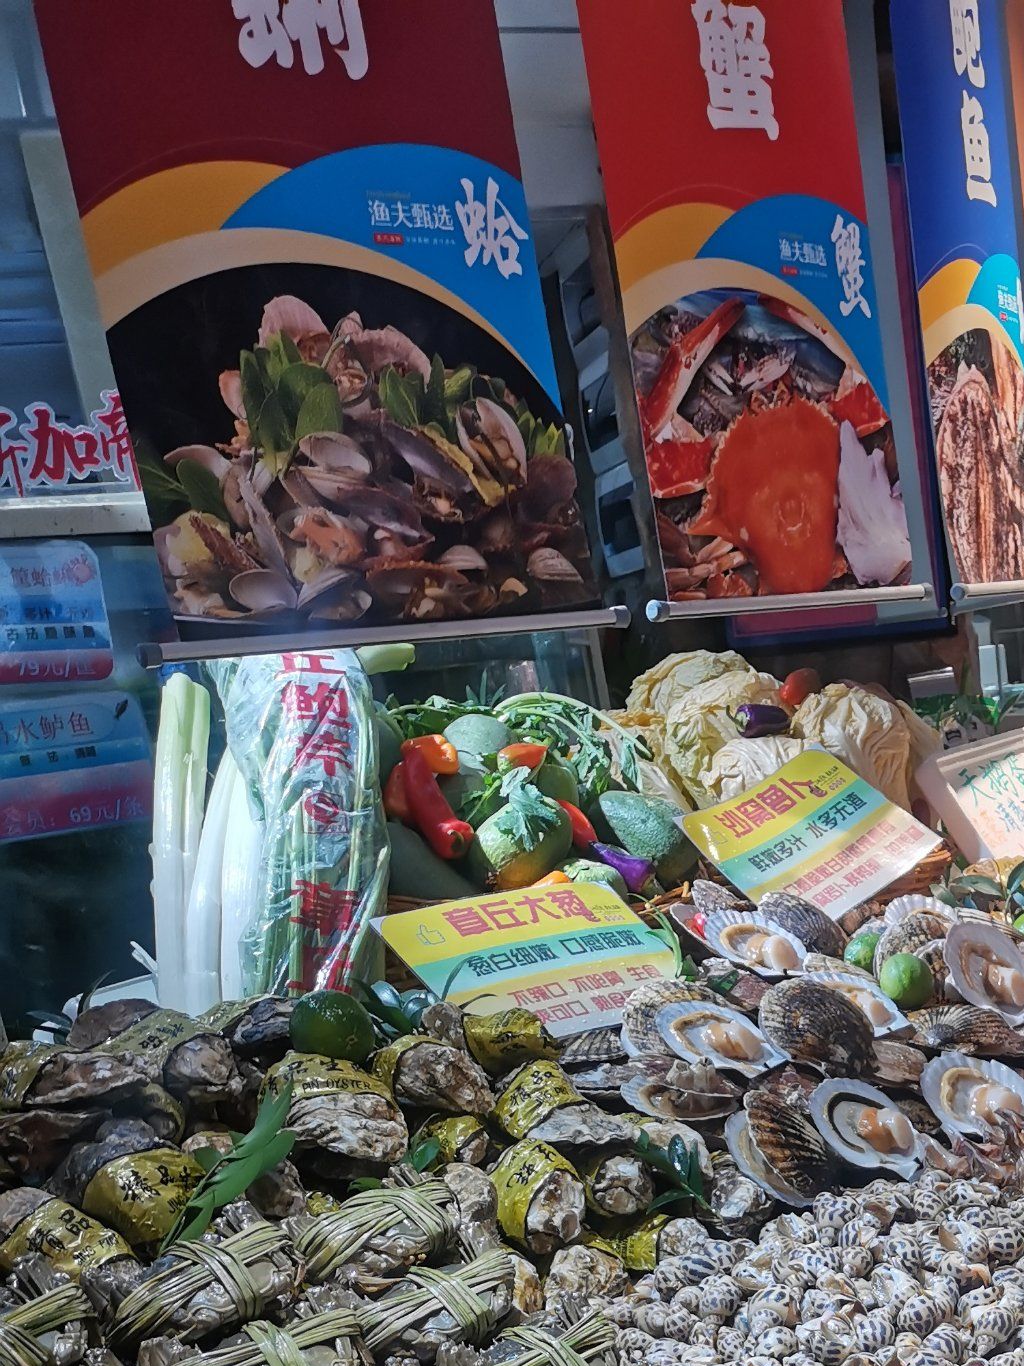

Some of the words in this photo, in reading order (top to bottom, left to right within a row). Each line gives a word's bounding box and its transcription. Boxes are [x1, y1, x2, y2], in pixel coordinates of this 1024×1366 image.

[691, 0, 779, 141] 蟹
[367, 199, 454, 231] 渔夫甄选
[455, 177, 529, 280] 蛤
[831, 214, 871, 319] 蟹
[442, 889, 600, 938] 章丘大葱
[468, 943, 561, 977] 葱白细嫩
[558, 929, 645, 956] 口感脆嫩
[507, 982, 568, 1006] 不辣口
[626, 965, 664, 981] 生食
[326, 1078, 371, 1090] OYSTER
